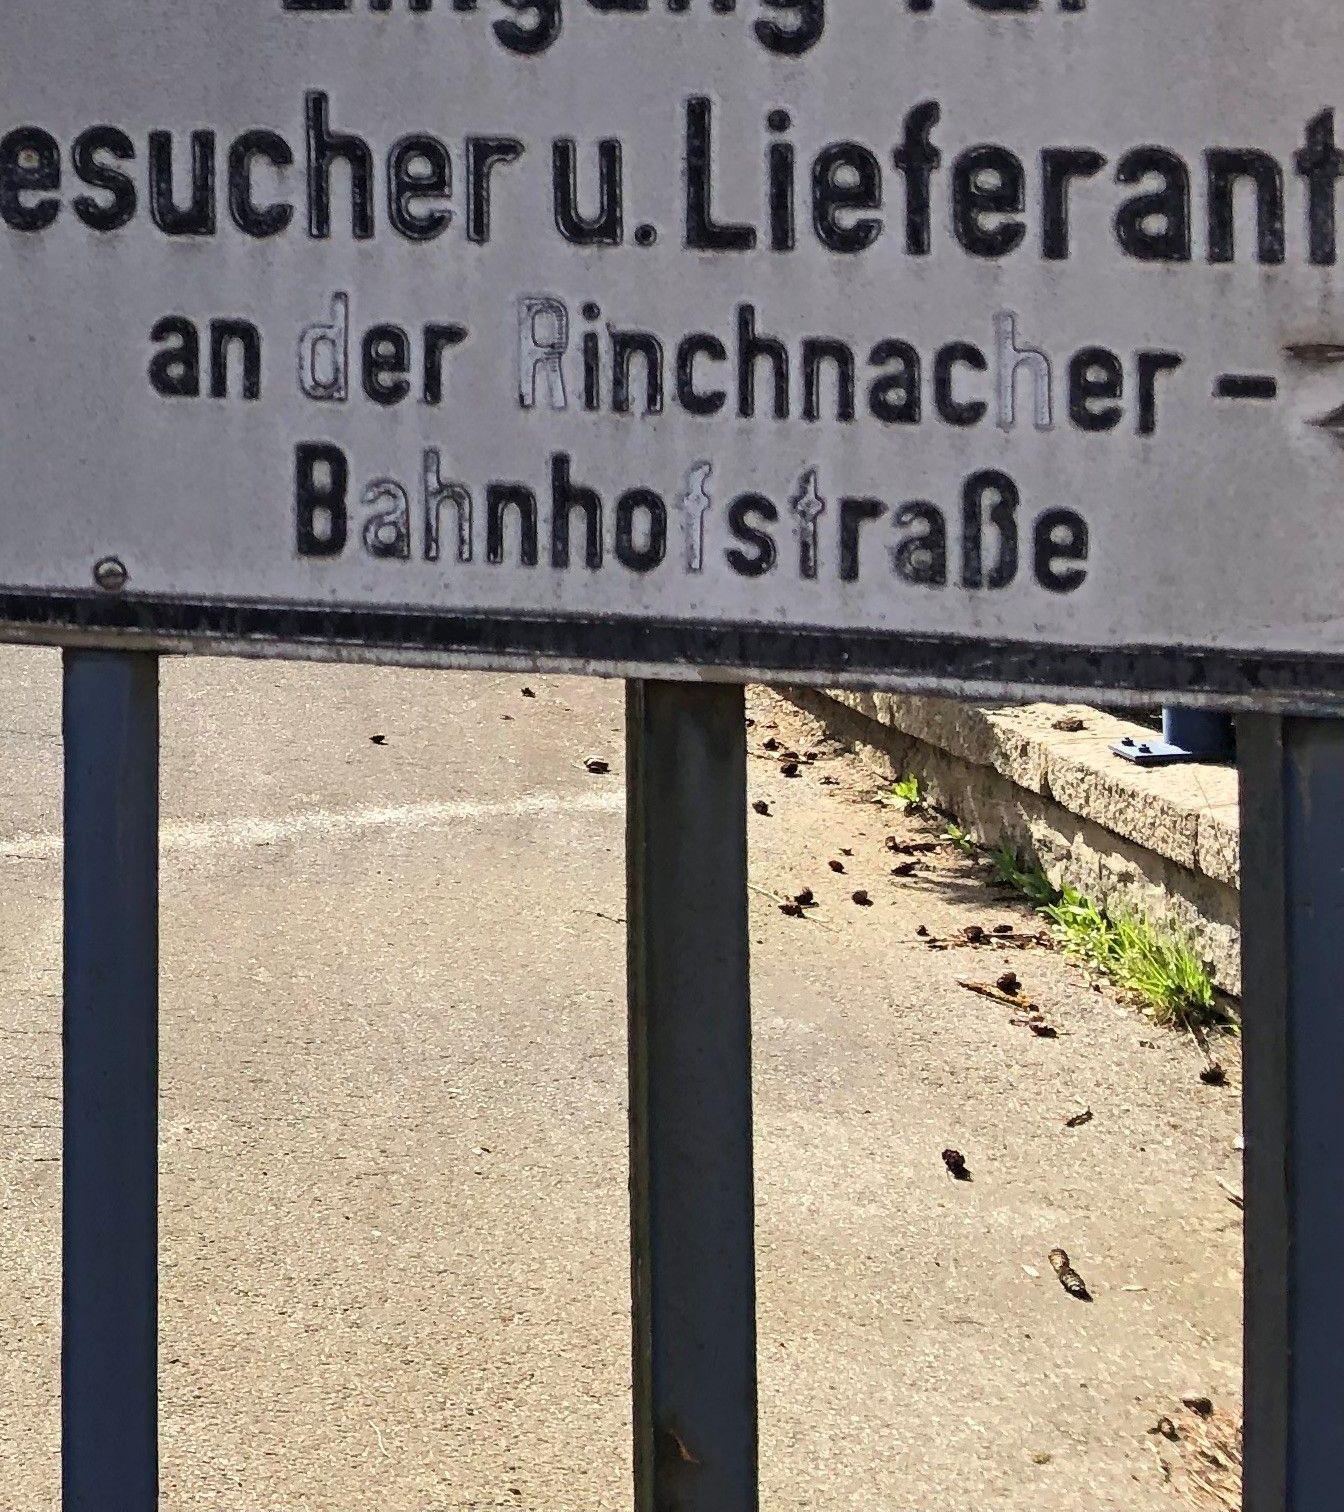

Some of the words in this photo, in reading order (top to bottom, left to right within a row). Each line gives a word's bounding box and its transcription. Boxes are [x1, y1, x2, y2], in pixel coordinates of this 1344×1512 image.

[550, 137, 656, 247] u.
[685, 95, 1344, 265] Lieferant
[148, 310, 262, 402] an
[299, 292, 468, 409] der
[294, 441, 1090, 593] Bahnhofstraße
